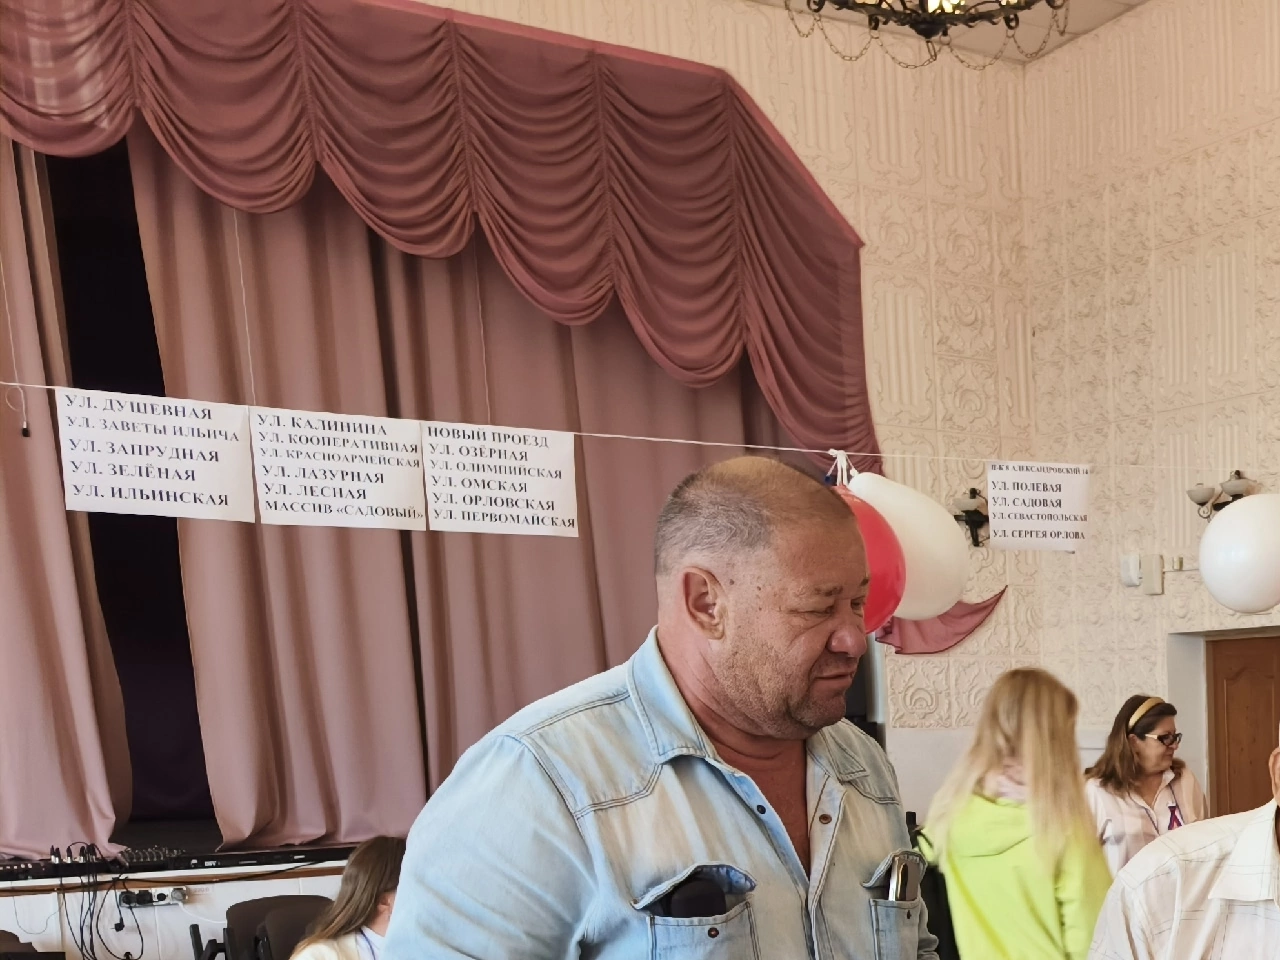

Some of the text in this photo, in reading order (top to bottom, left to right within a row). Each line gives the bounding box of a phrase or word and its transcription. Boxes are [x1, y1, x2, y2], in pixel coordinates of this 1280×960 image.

[65, 394, 212, 420] УЛ. ДУШЕВНАЯ
[66, 416, 239, 442] УЛ. ЗАВЕТЫ ИЛЬИЧА
[257, 414, 387, 436] УЛ. КАЛИНИНА
[259, 431, 418, 454] УЛ. КООПЕРАТИВНАЯ
[428, 426, 550, 448] НОВЫЙ ПРОЕЗД
[69, 439, 220, 462] УЛ. ЗАПРУДНАЯ
[260, 448, 420, 468] УЛ. КРАСНОАРМЕЙСКАЯ
[429, 443, 529, 462] УЛ. ОЗЁРНАЯ
[70, 461, 196, 481] УЛ. ЗЕЛЁНАЯ
[262, 464, 384, 484] УЛ. ЛАЗУРНАЯ
[429, 459, 562, 479] УЛ. ОЛИМПИЙСКАЯ
[263, 482, 367, 500] УЛ. ЛЕСНАЯ
[431, 475, 528, 493] УЛ. ОМСКАЯ
[991, 481, 1062, 493] УЛ. ПОЛЕВАЯ
[73, 484, 228, 506] УЛ. ИЛЬИНСКАЯ
[432, 492, 555, 511] УЛ. ОРЛОВСКАЯ
[992, 497, 1062, 508] УЛ. САДОВАЯ
[265, 500, 424, 519] МАССИВ «САДОВЫЙ»
[433, 509, 575, 528] УЛ. ПЕРВОМАЙСКАЯ
[992, 512, 1088, 522] УЛ. СЕВАСТОПОЛЬСКАЯ
[993, 530, 1085, 539] УЛ. СЕРГЕЯ ОРЛОВА
